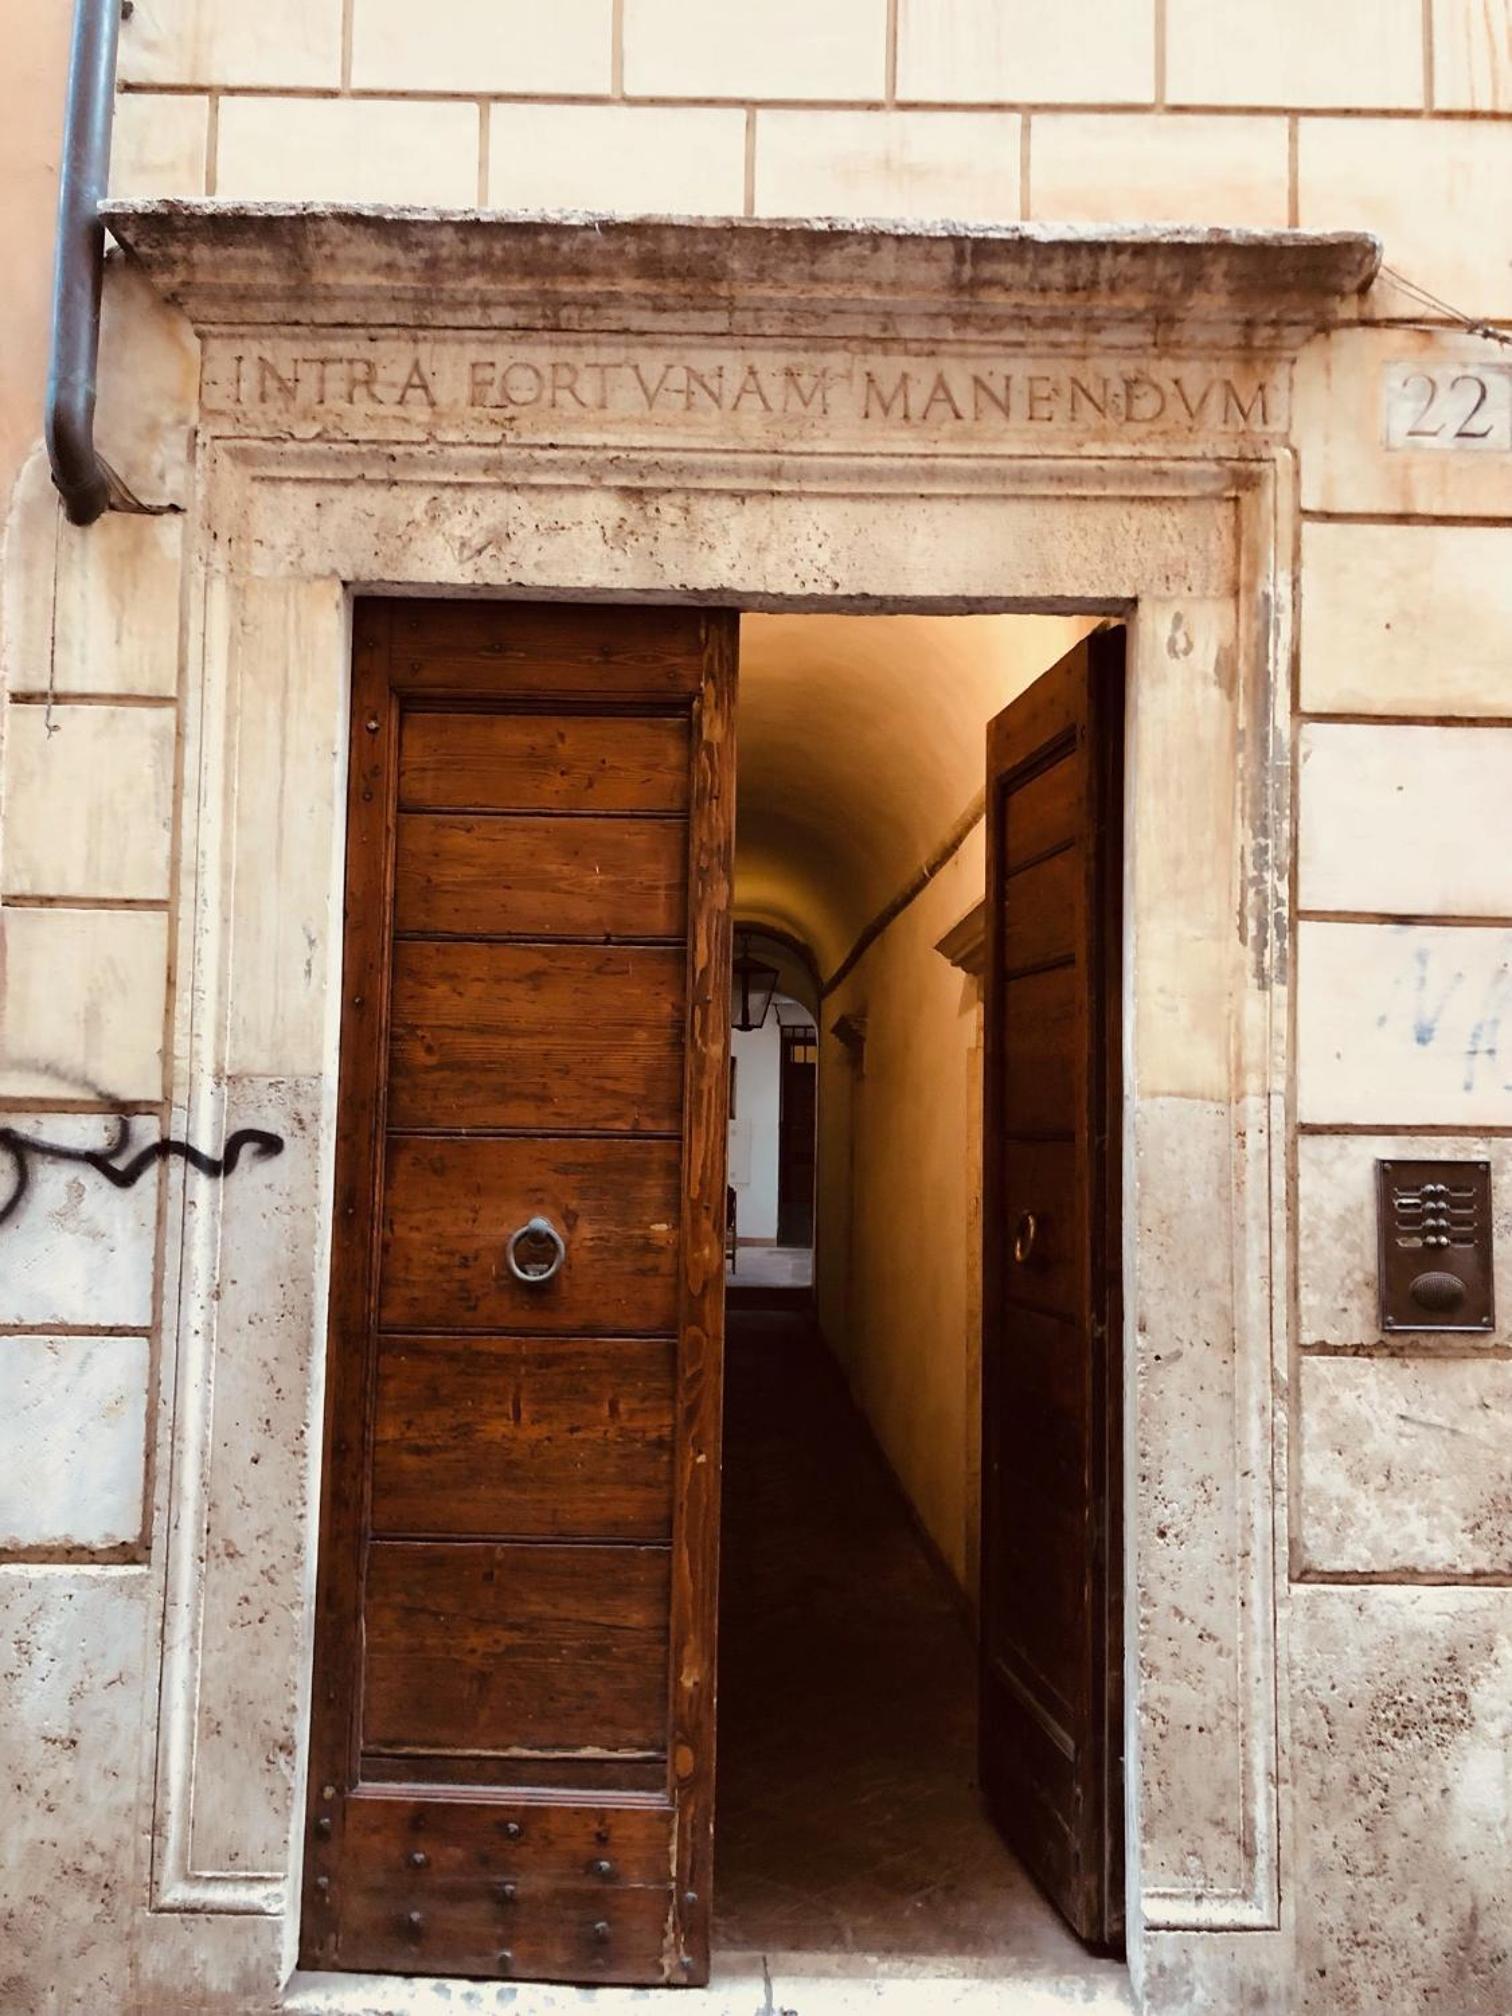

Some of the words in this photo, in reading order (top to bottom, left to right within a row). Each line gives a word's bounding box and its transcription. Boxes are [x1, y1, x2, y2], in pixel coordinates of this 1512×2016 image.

[234, 355, 437, 408] INTRA
[863, 369, 1271, 427] MANENDVM
[1402, 374, 1494, 439] 22
